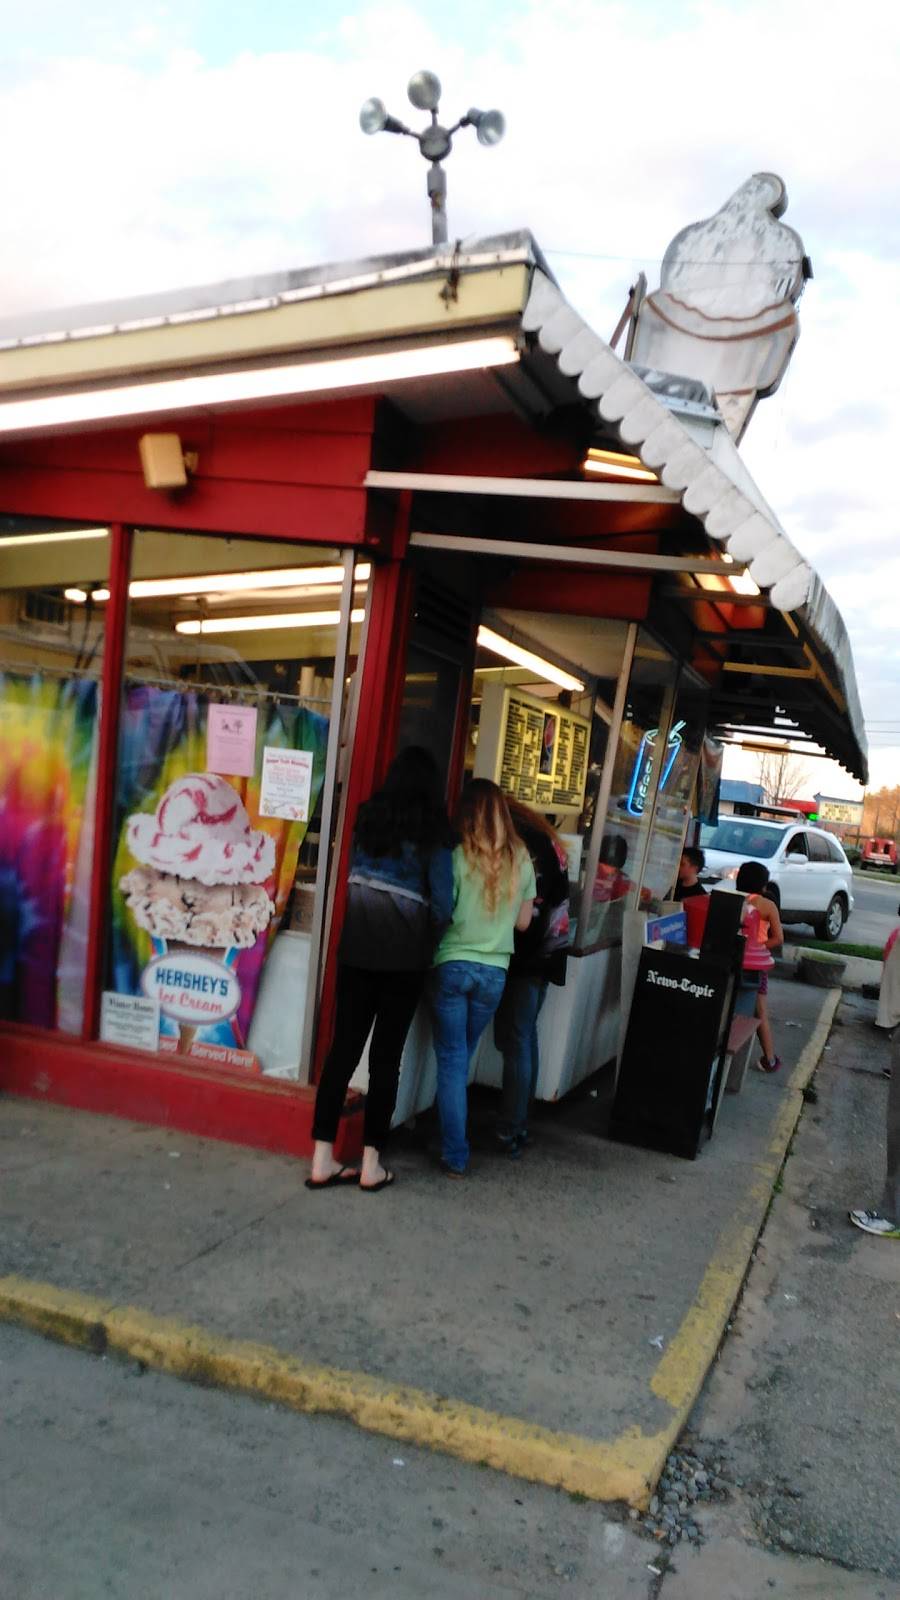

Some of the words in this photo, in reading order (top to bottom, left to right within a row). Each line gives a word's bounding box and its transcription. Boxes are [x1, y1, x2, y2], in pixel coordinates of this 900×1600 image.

[156, 967, 229, 996] HERSHEY'S
[646, 969, 716, 998] News-Topic
[159, 988, 174, 1003] Ice
[179, 992, 223, 1013] Cream
[191, 1044, 226, 1062] Served
